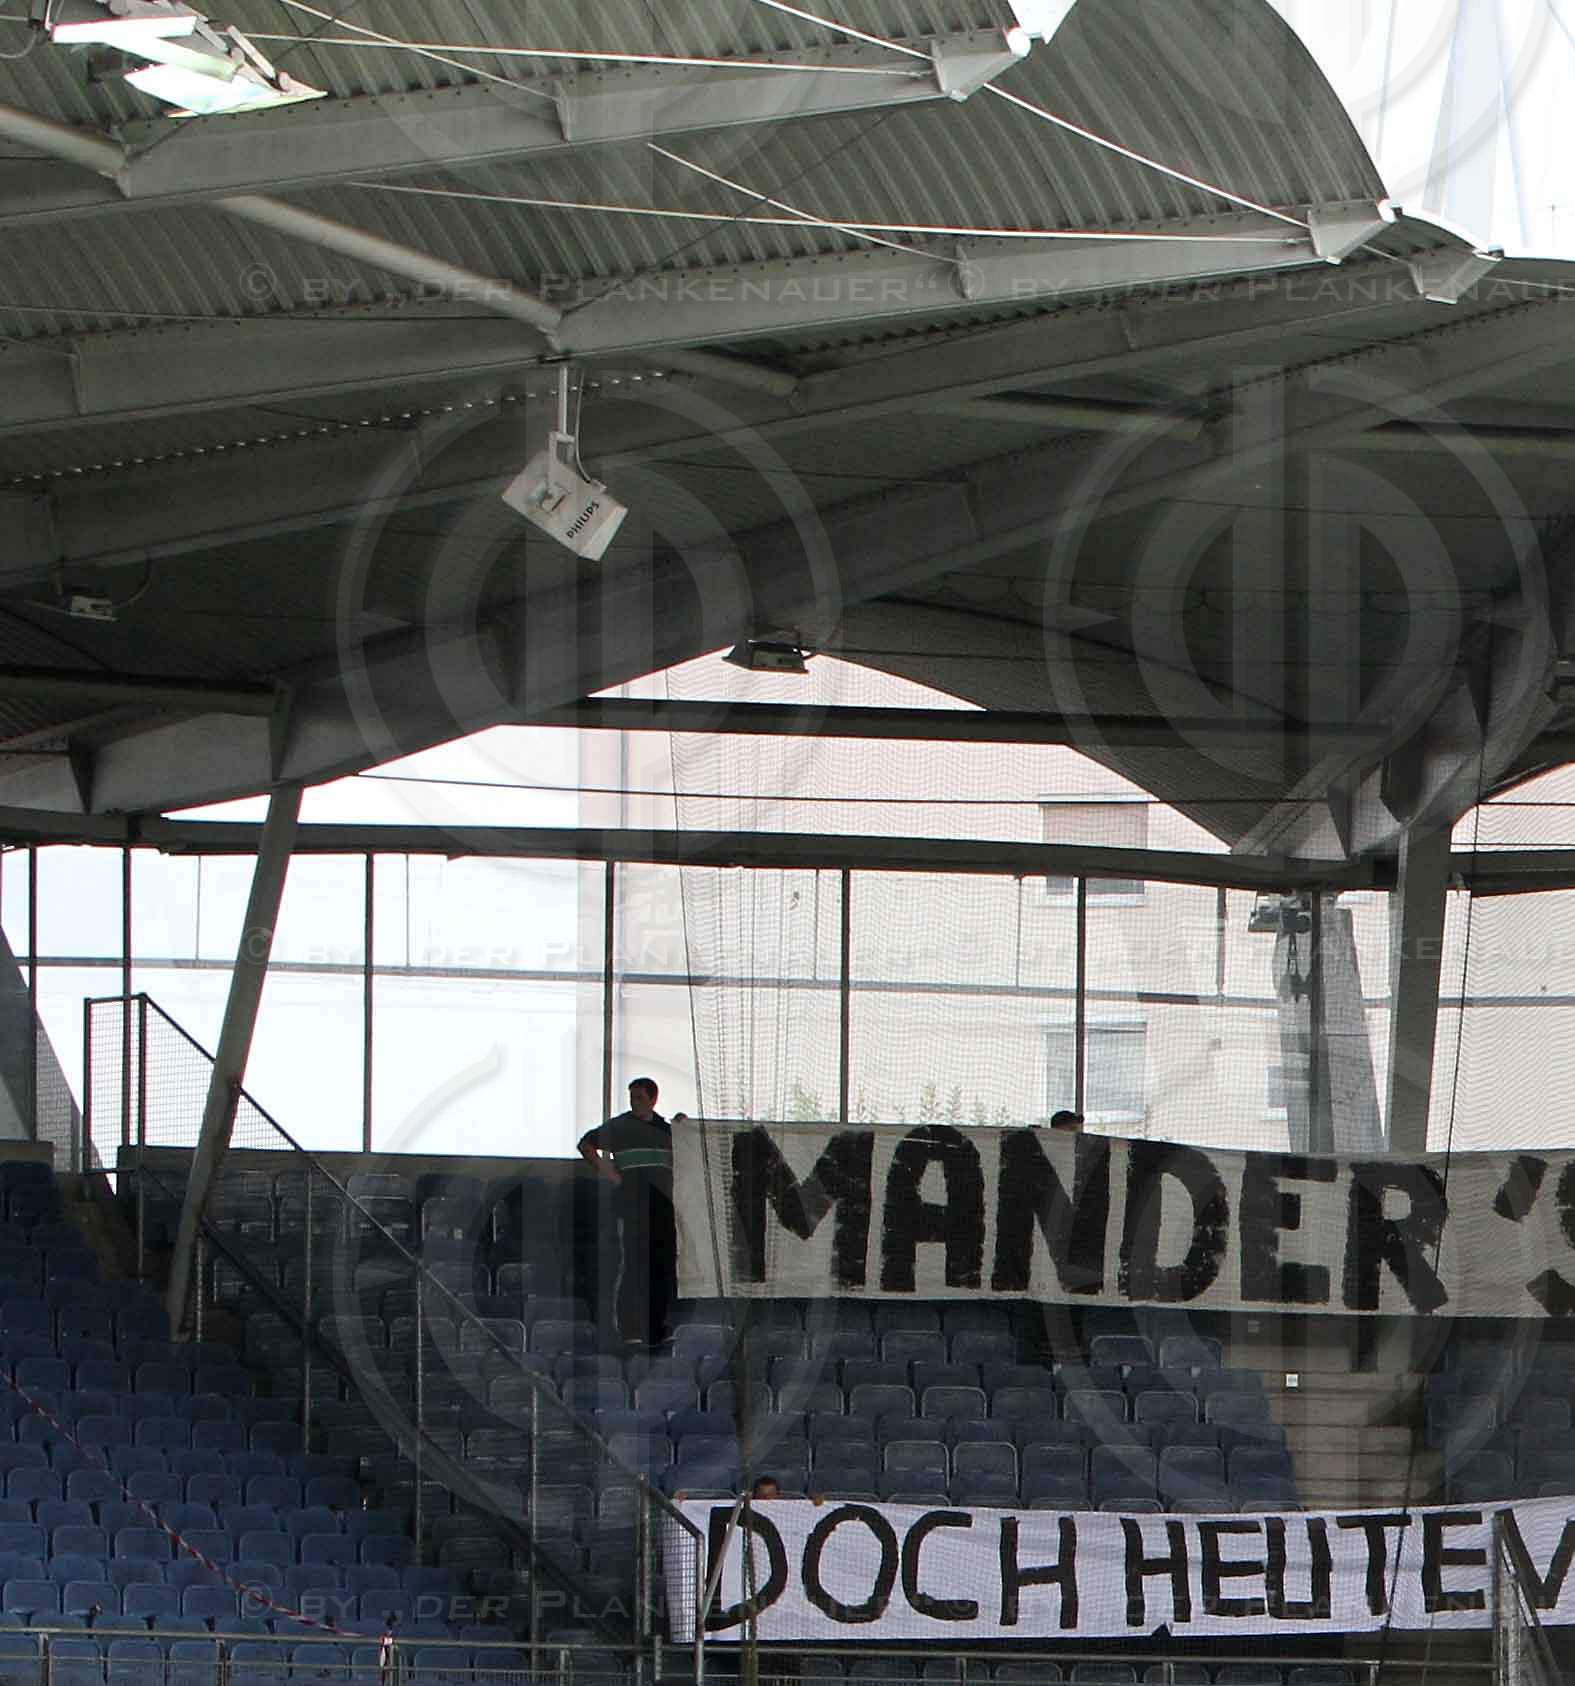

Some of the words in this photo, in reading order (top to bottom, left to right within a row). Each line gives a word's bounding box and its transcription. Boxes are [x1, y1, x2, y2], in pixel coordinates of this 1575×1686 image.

[566, 501, 600, 539] PHILIPS
[703, 1503, 1079, 1632] DOCH
[1124, 1510, 1489, 1628] HEUTE
